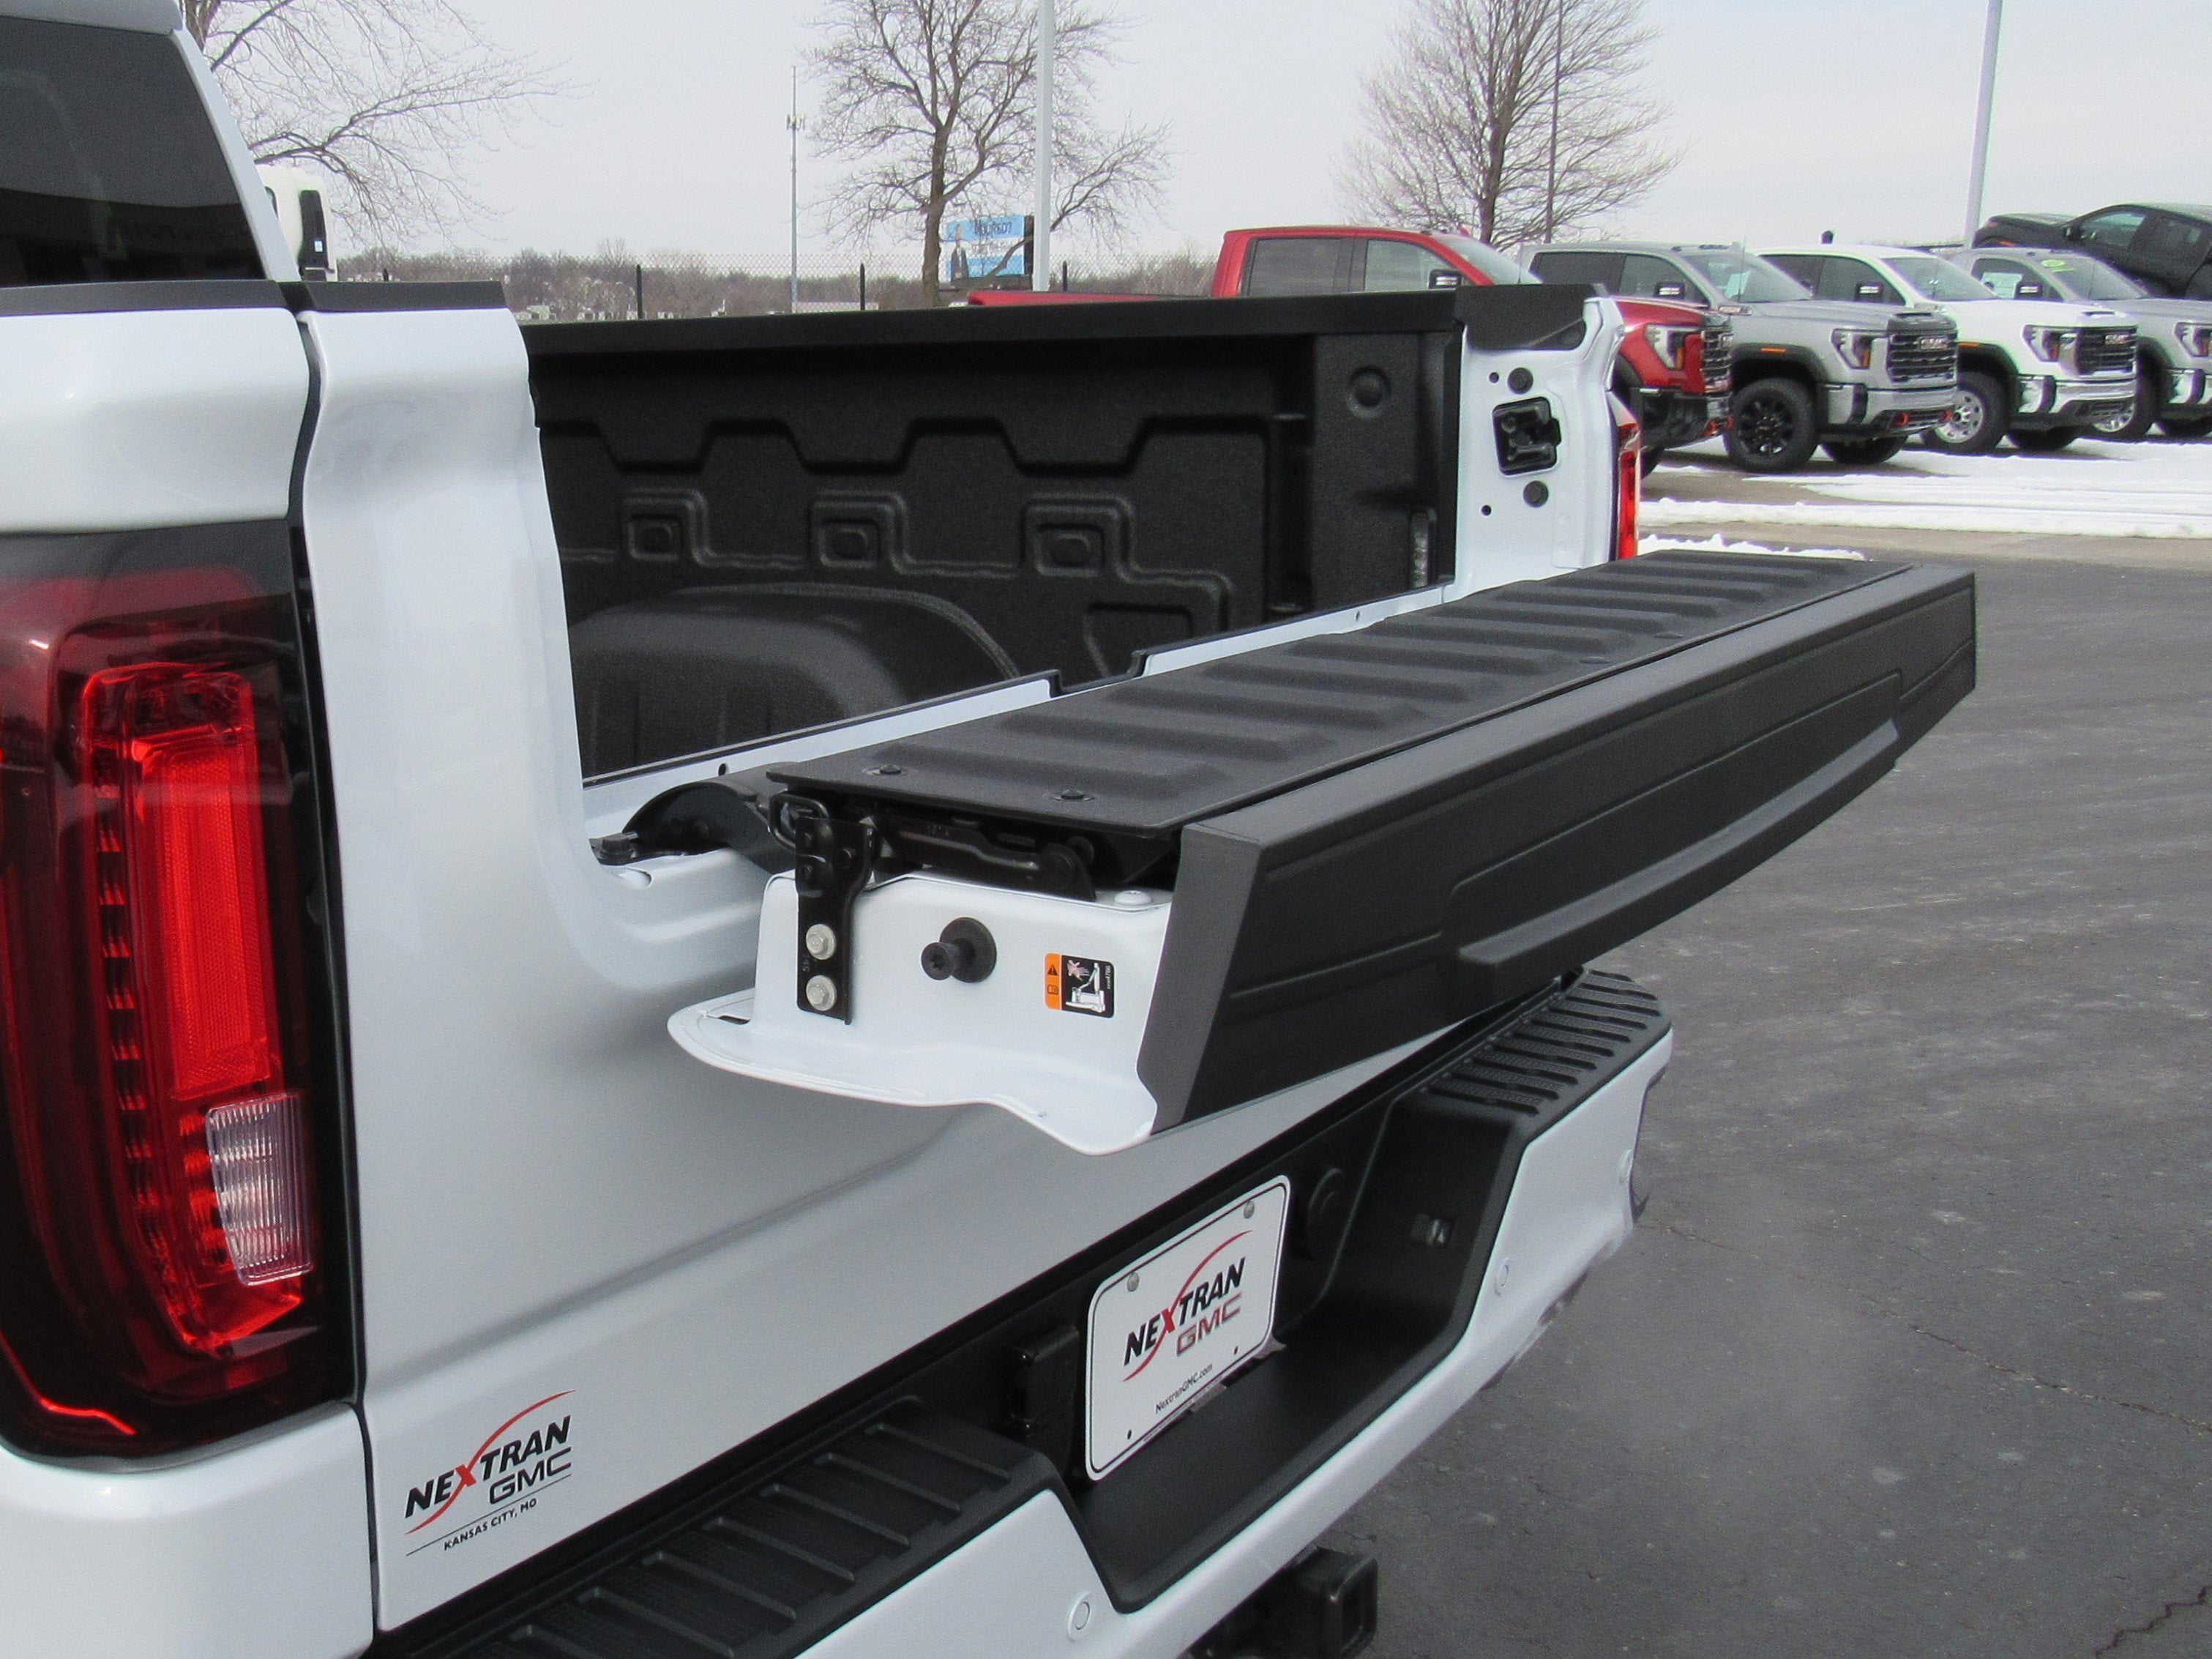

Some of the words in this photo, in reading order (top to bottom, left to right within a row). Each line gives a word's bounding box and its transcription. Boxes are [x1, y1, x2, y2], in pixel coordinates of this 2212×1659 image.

[1921, 338, 1947, 348] GMC
[1124, 1258, 1246, 1365] NEXTRAN
[1176, 1294, 1241, 1357] GMC
[1156, 1363, 1213, 1414] NextranGMC.com
[405, 1415, 571, 1518] NEXTRAN
[490, 1447, 572, 1505] GMC
[444, 1521, 488, 1551] KANSAS
[490, 1508, 517, 1527] CITY,
[520, 1498, 537, 1513] MO
